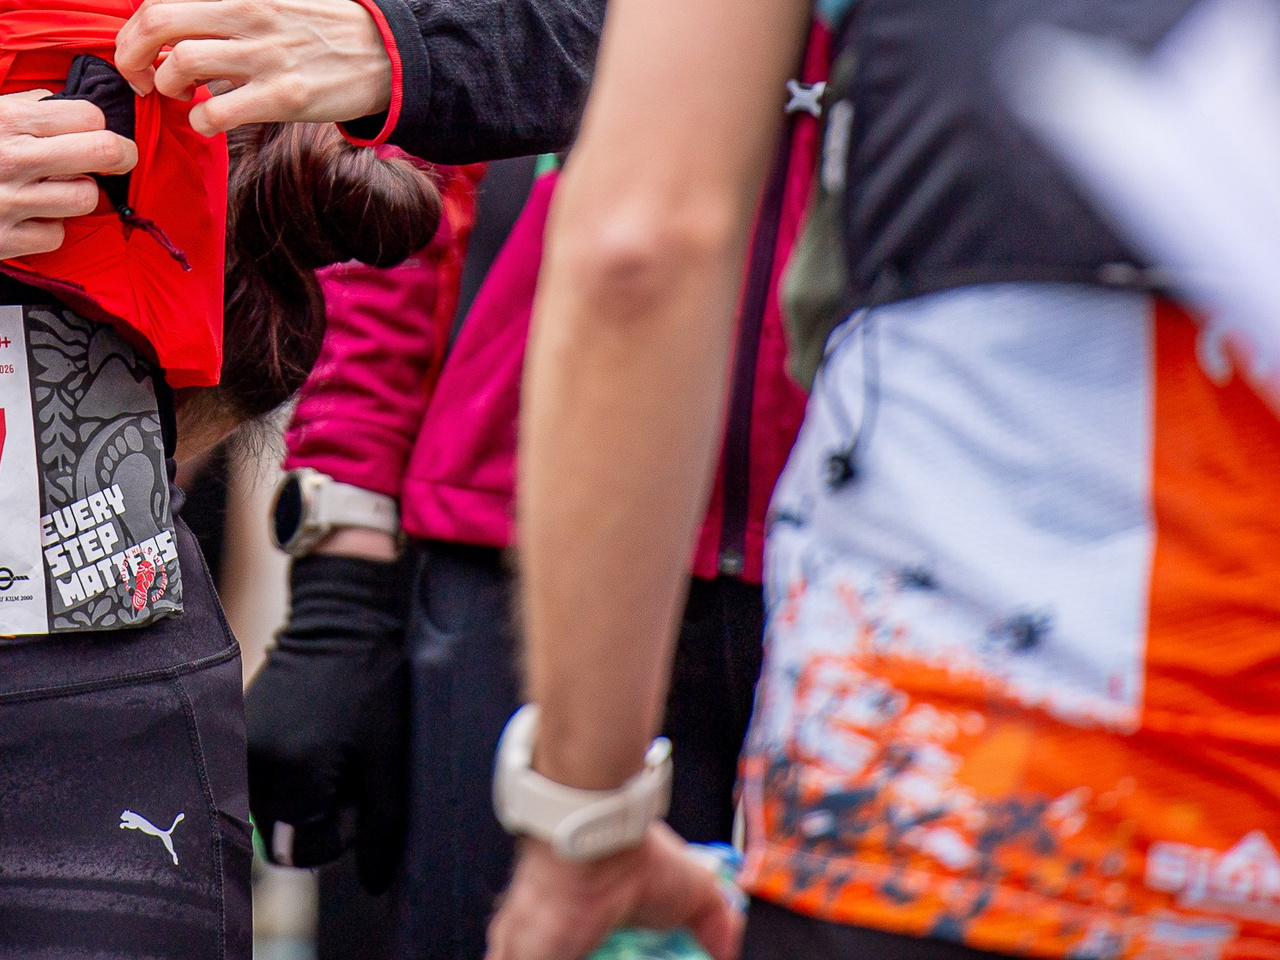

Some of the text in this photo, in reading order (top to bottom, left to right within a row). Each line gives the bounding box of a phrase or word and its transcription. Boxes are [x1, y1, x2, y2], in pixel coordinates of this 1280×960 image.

[40, 483, 126, 547] EVERY
[44, 522, 119, 577] STEP
[56, 530, 178, 607] MATTERS
